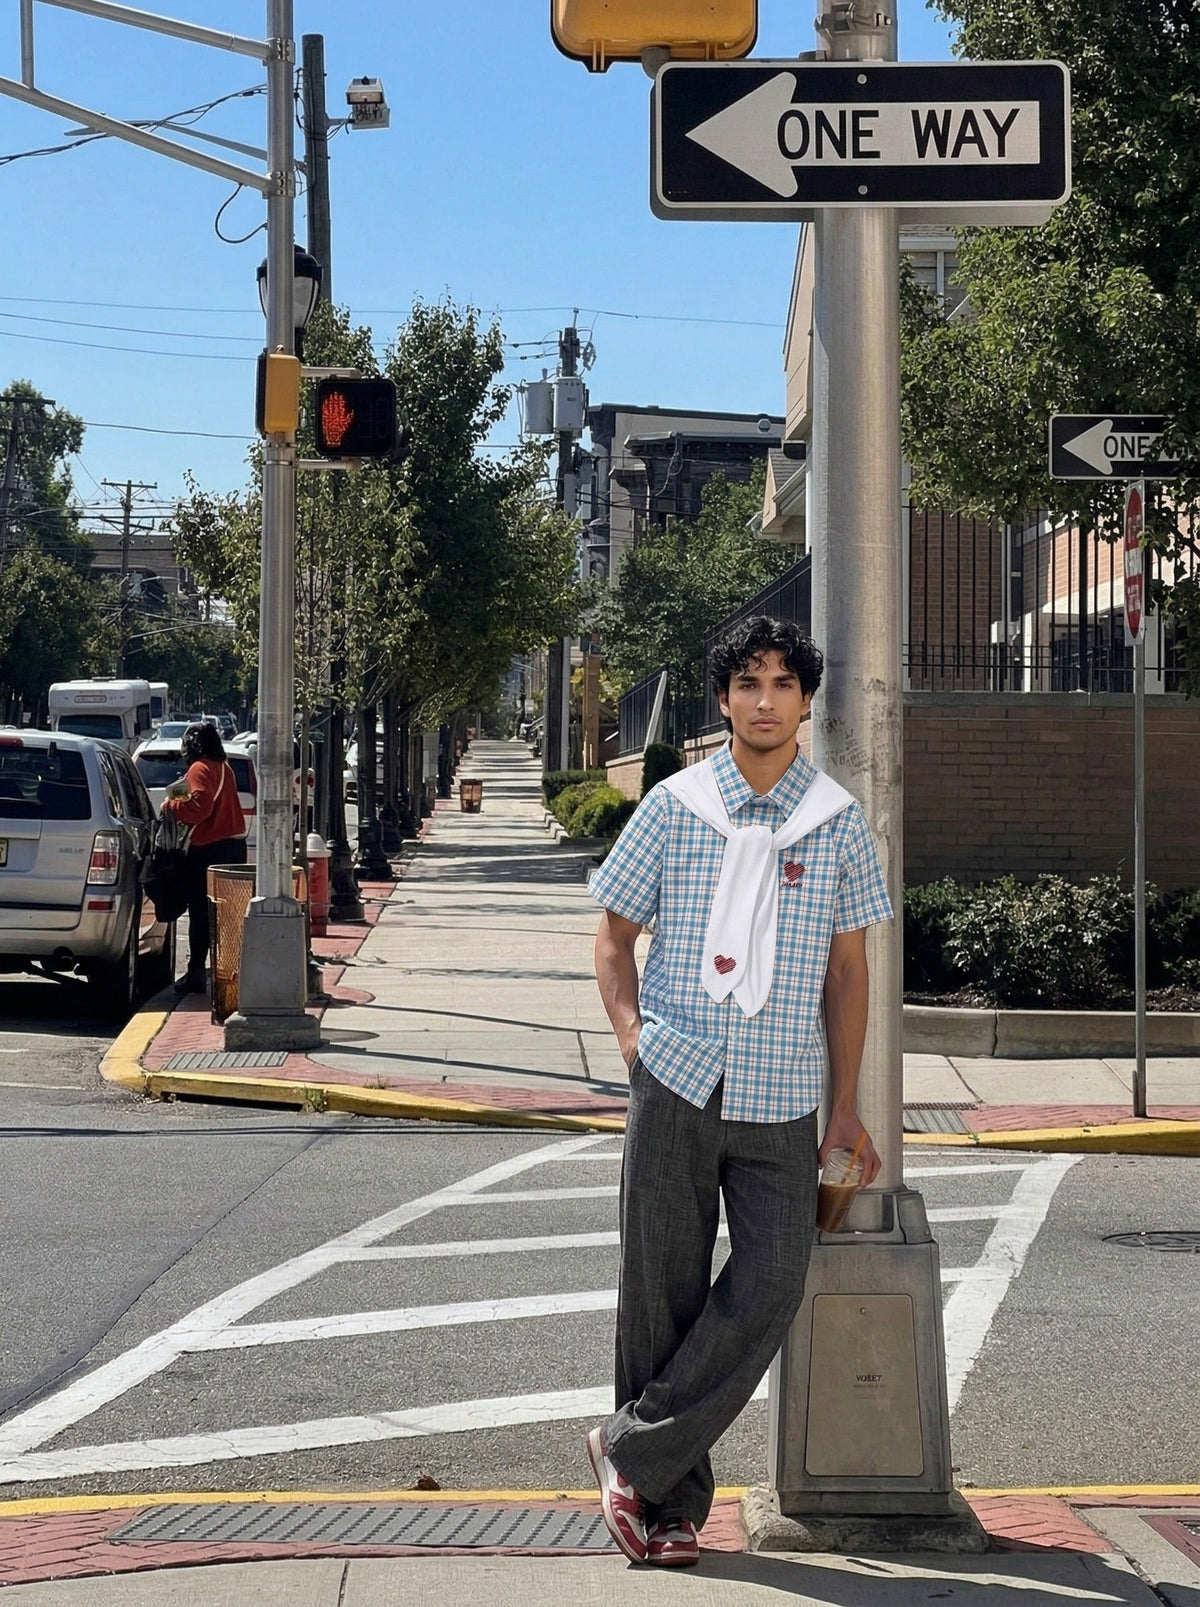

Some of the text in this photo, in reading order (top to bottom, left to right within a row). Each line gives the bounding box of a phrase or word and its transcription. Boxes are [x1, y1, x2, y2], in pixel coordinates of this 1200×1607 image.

[777, 108, 1020, 160] ONE WAY
[1103, 435, 1150, 459] ONE
